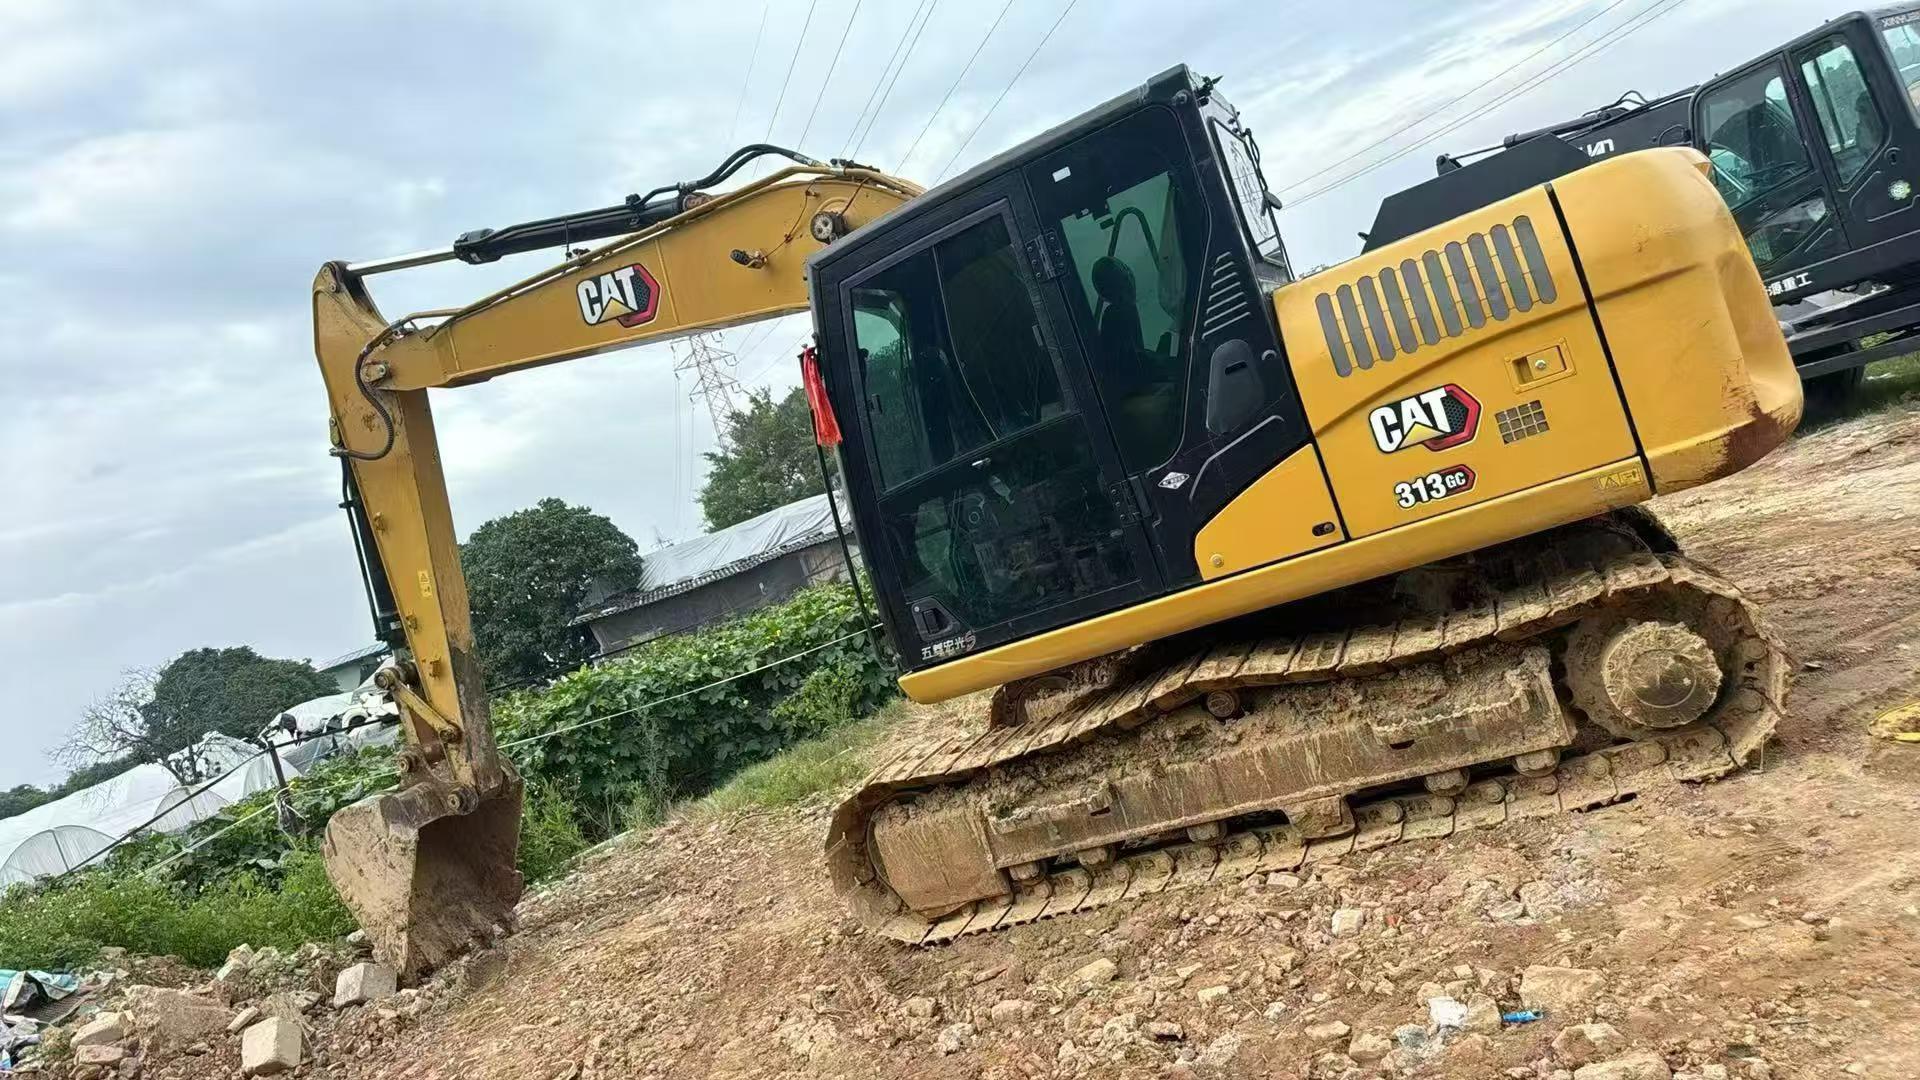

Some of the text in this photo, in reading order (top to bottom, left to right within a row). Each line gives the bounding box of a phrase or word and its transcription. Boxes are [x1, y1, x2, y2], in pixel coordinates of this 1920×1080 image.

[577, 266, 639, 325] CAT
[1764, 272, 1813, 297] 源重工
[1369, 387, 1452, 453] CAT
[1394, 471, 1466, 508] 313 GC
